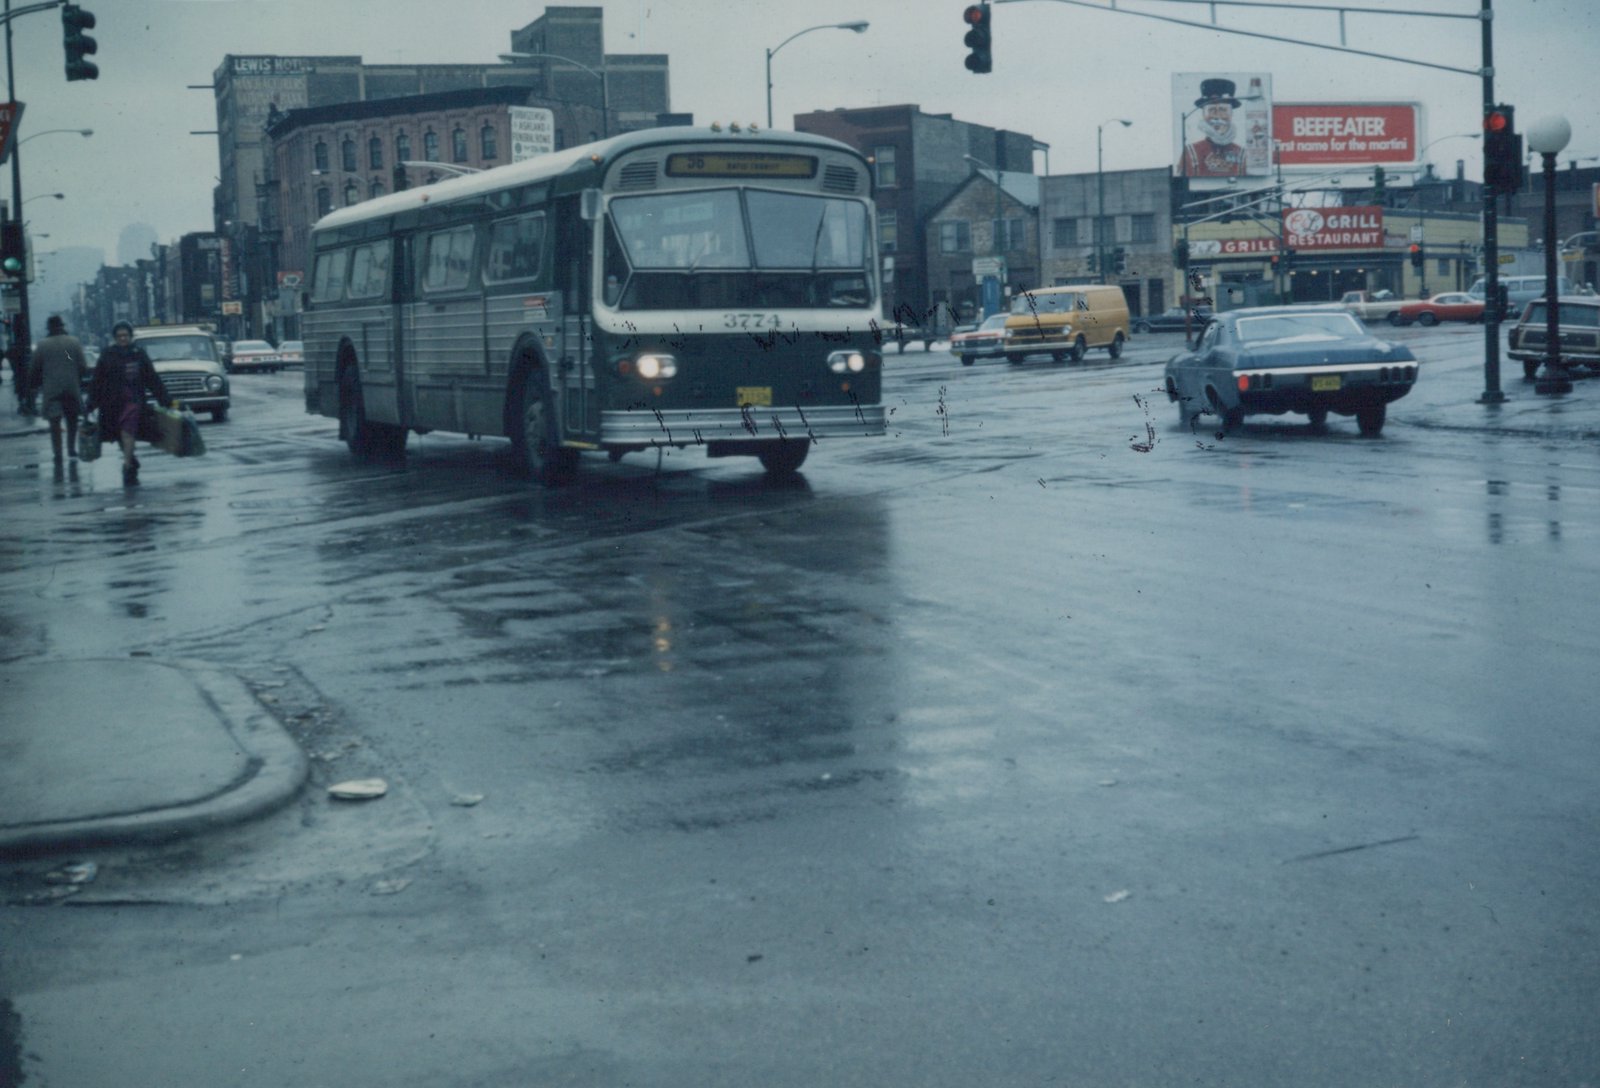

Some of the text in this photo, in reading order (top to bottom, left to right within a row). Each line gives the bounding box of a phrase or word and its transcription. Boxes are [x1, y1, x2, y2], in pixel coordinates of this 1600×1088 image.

[234, 58, 271, 71] LEWIS
[1293, 117, 1386, 136] BEEFEATER
[1297, 141, 1329, 151] name
[1330, 137, 1347, 151] for
[1348, 137, 1367, 151] the
[1369, 137, 1408, 150] martini
[1327, 214, 1380, 229] GRILL
[1288, 232, 1380, 246] RESTAURANT
[1225, 240, 1276, 253] GRILL
[723, 313, 781, 328] 3774
